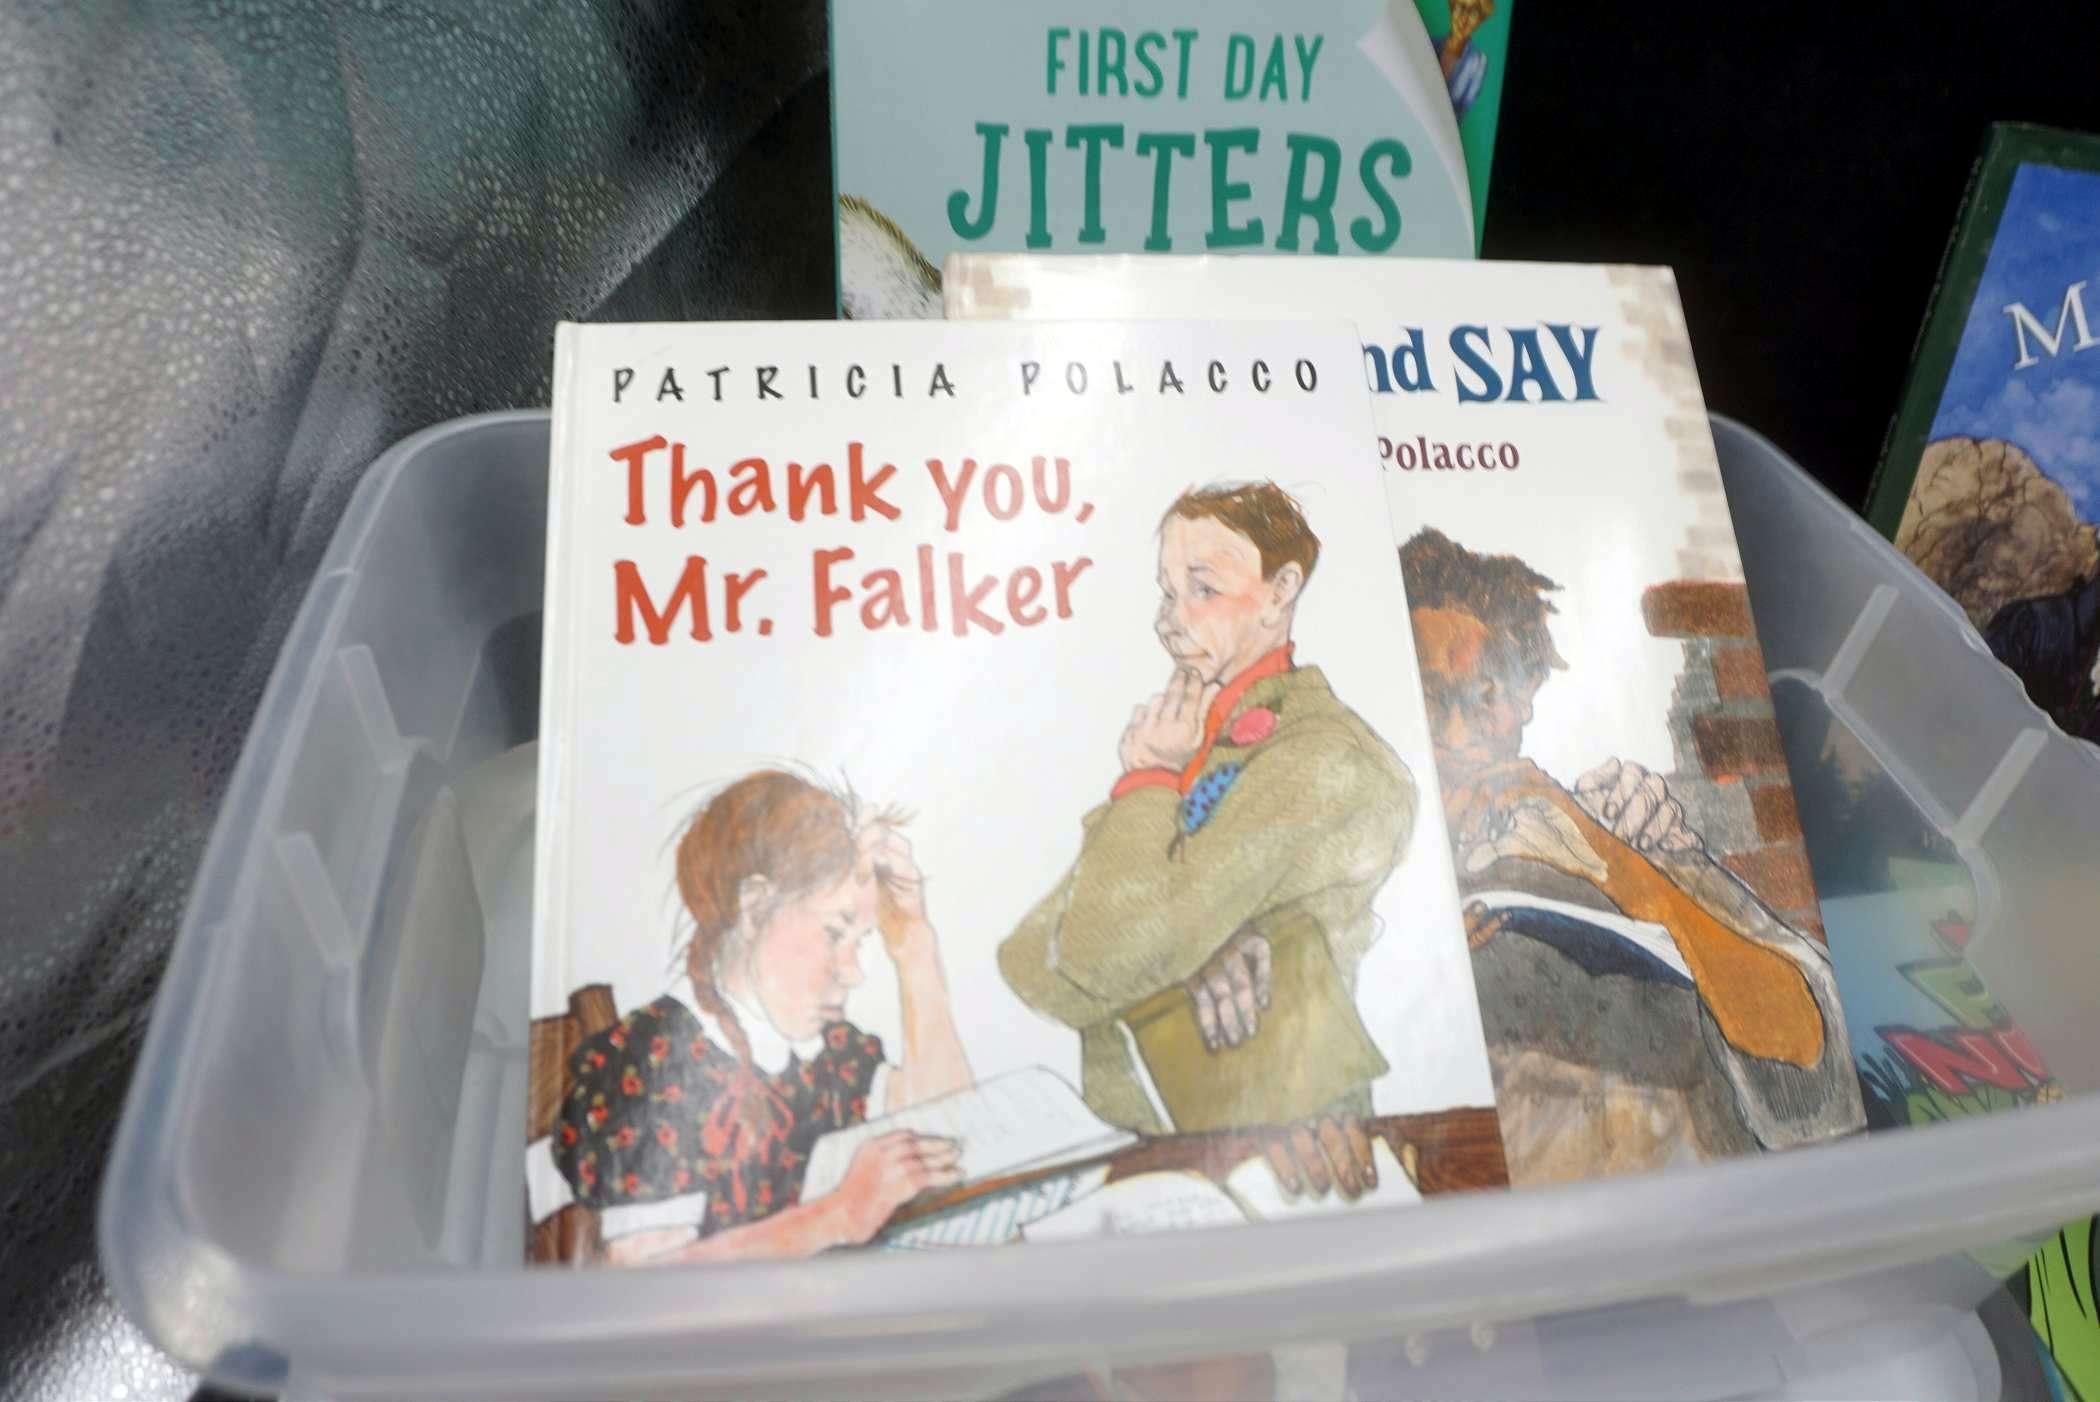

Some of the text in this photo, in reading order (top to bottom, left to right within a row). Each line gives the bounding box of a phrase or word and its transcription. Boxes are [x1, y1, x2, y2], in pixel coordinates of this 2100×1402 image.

[1047, 28, 1324, 102] FIRST DAY
[947, 122, 1412, 255] JITTERS
[612, 359, 1318, 402] PATRICIA POLACCO
[1362, 322, 1603, 404] nd SAY
[608, 433, 1094, 533] Thank you,
[613, 544, 1092, 647] Mr. Falker
